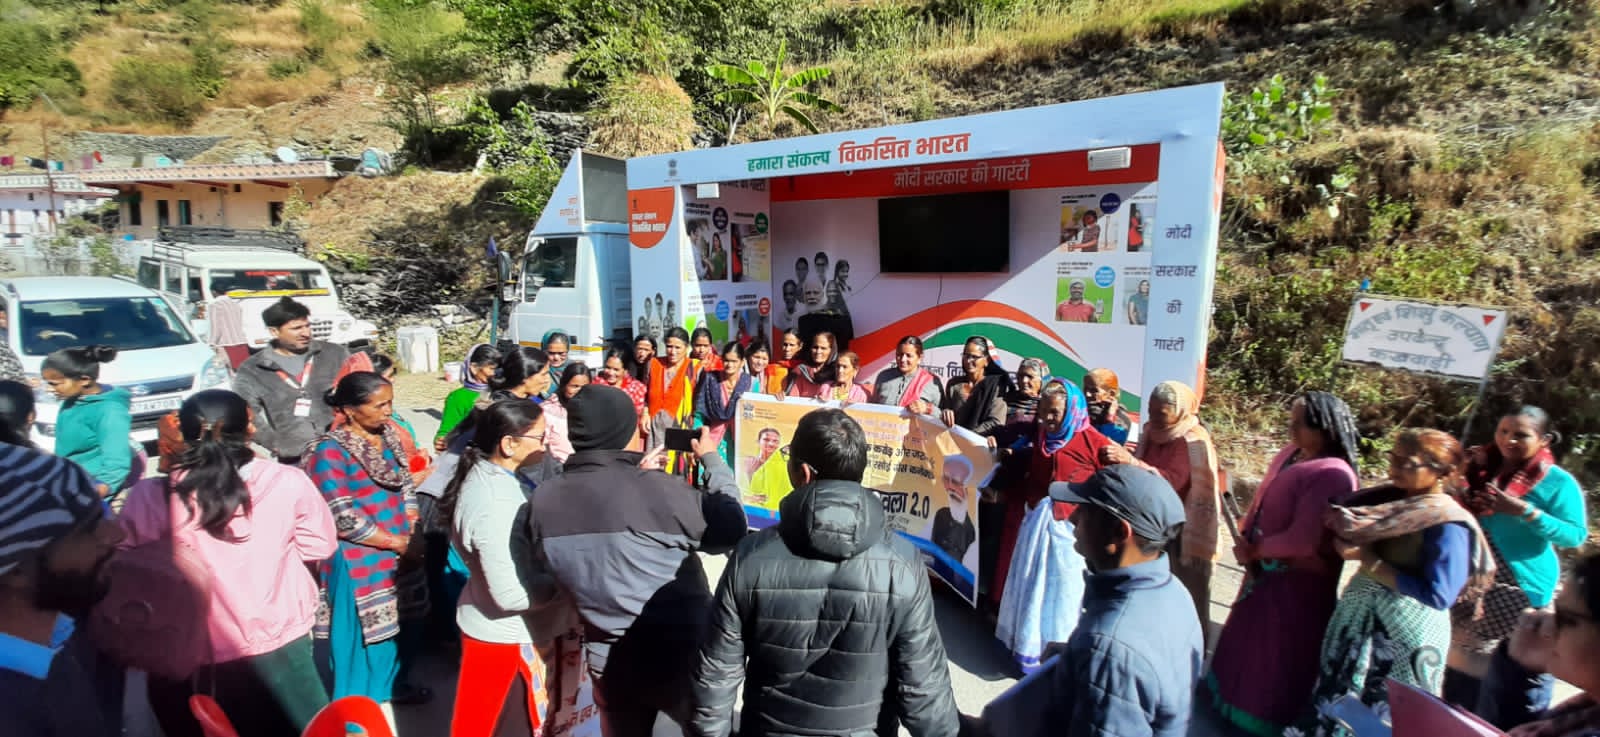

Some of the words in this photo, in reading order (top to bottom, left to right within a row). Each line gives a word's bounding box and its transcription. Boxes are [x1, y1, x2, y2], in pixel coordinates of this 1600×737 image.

[746, 155, 783, 172] हमारा
[787, 150, 831, 168] संकल्प
[837, 136, 912, 164] विकसित
[915, 132, 972, 155] भारत
[894, 167, 921, 188] मोदी
[924, 165, 968, 187] सरकार
[971, 161, 988, 183] की
[991, 159, 1032, 181] गारंटी
[1165, 223, 1192, 239] मोदी
[1154, 264, 1197, 278] सरकार
[1166, 299, 1182, 314] की
[1153, 337, 1185, 352] गारंटी
[910, 491, 930, 519] 2.0
